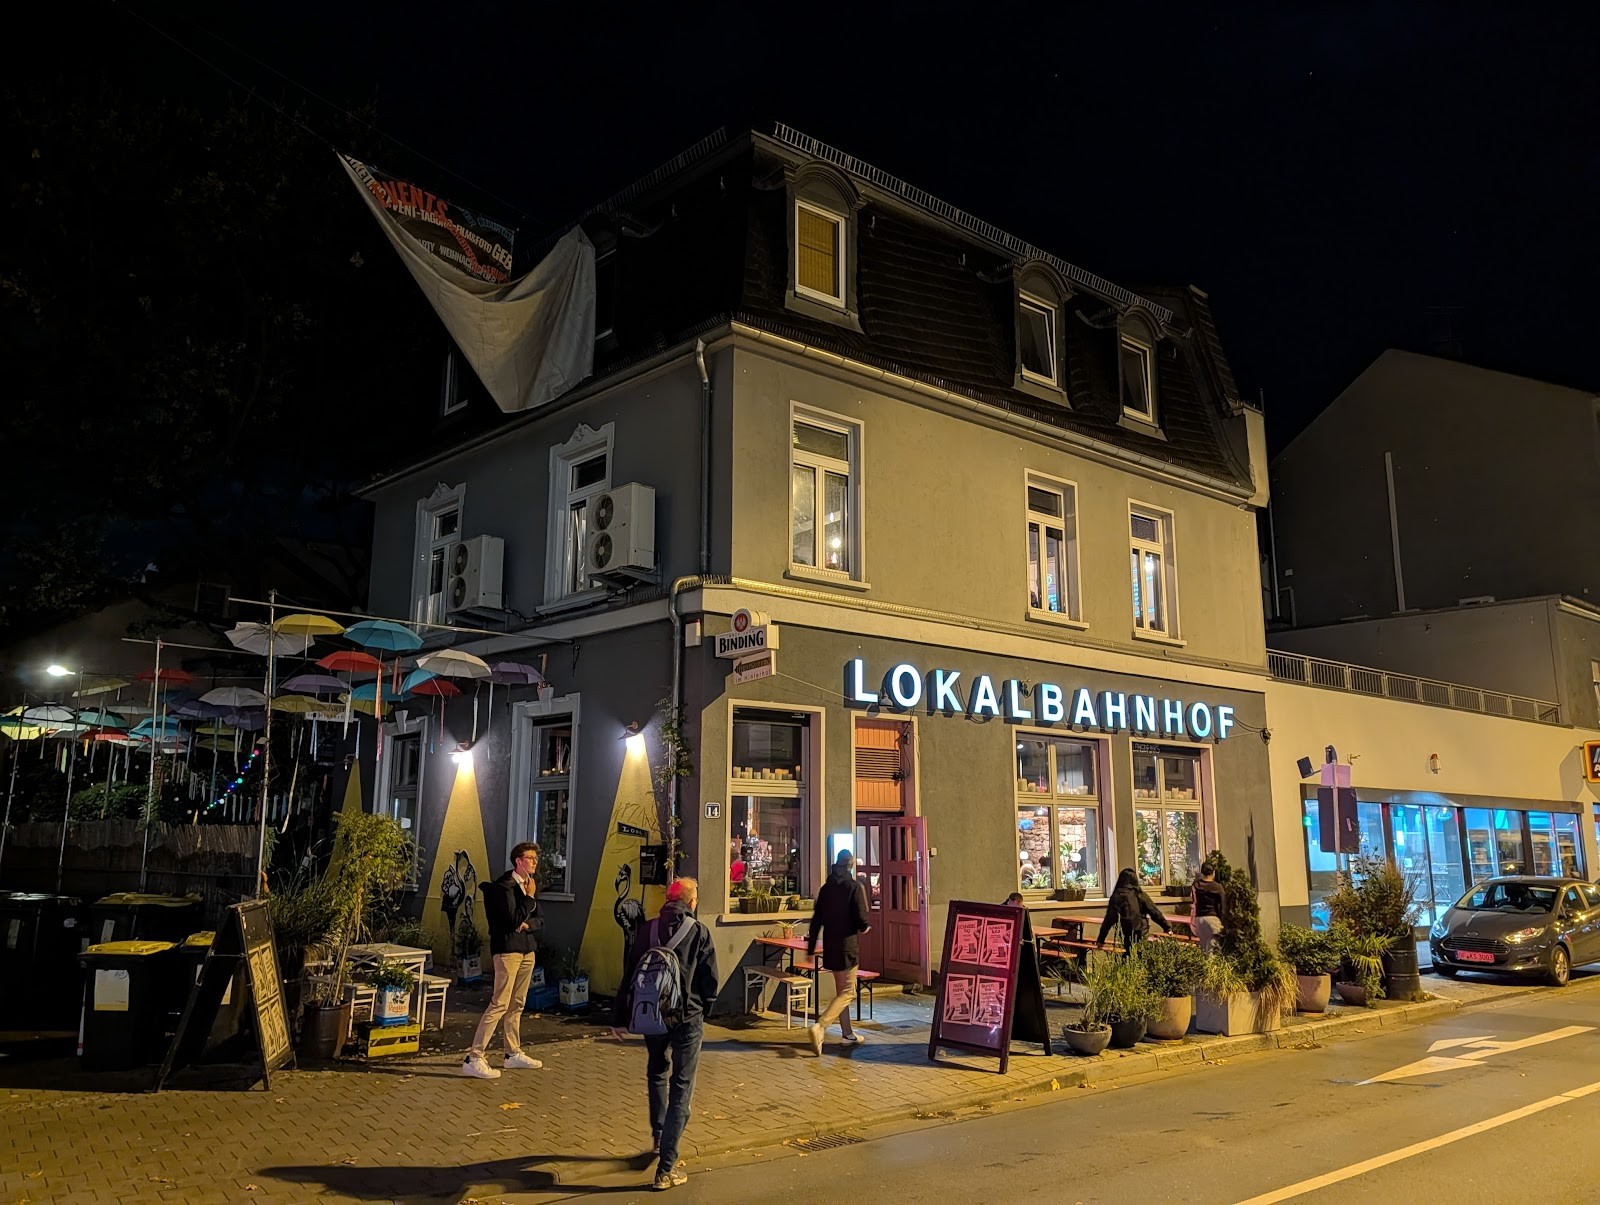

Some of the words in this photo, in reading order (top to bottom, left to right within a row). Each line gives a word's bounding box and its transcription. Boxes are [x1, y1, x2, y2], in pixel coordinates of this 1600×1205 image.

[720, 630, 764, 653] BINDING
[853, 657, 1235, 741] LOKALBAHNHOF
[707, 806, 719, 817] 14
